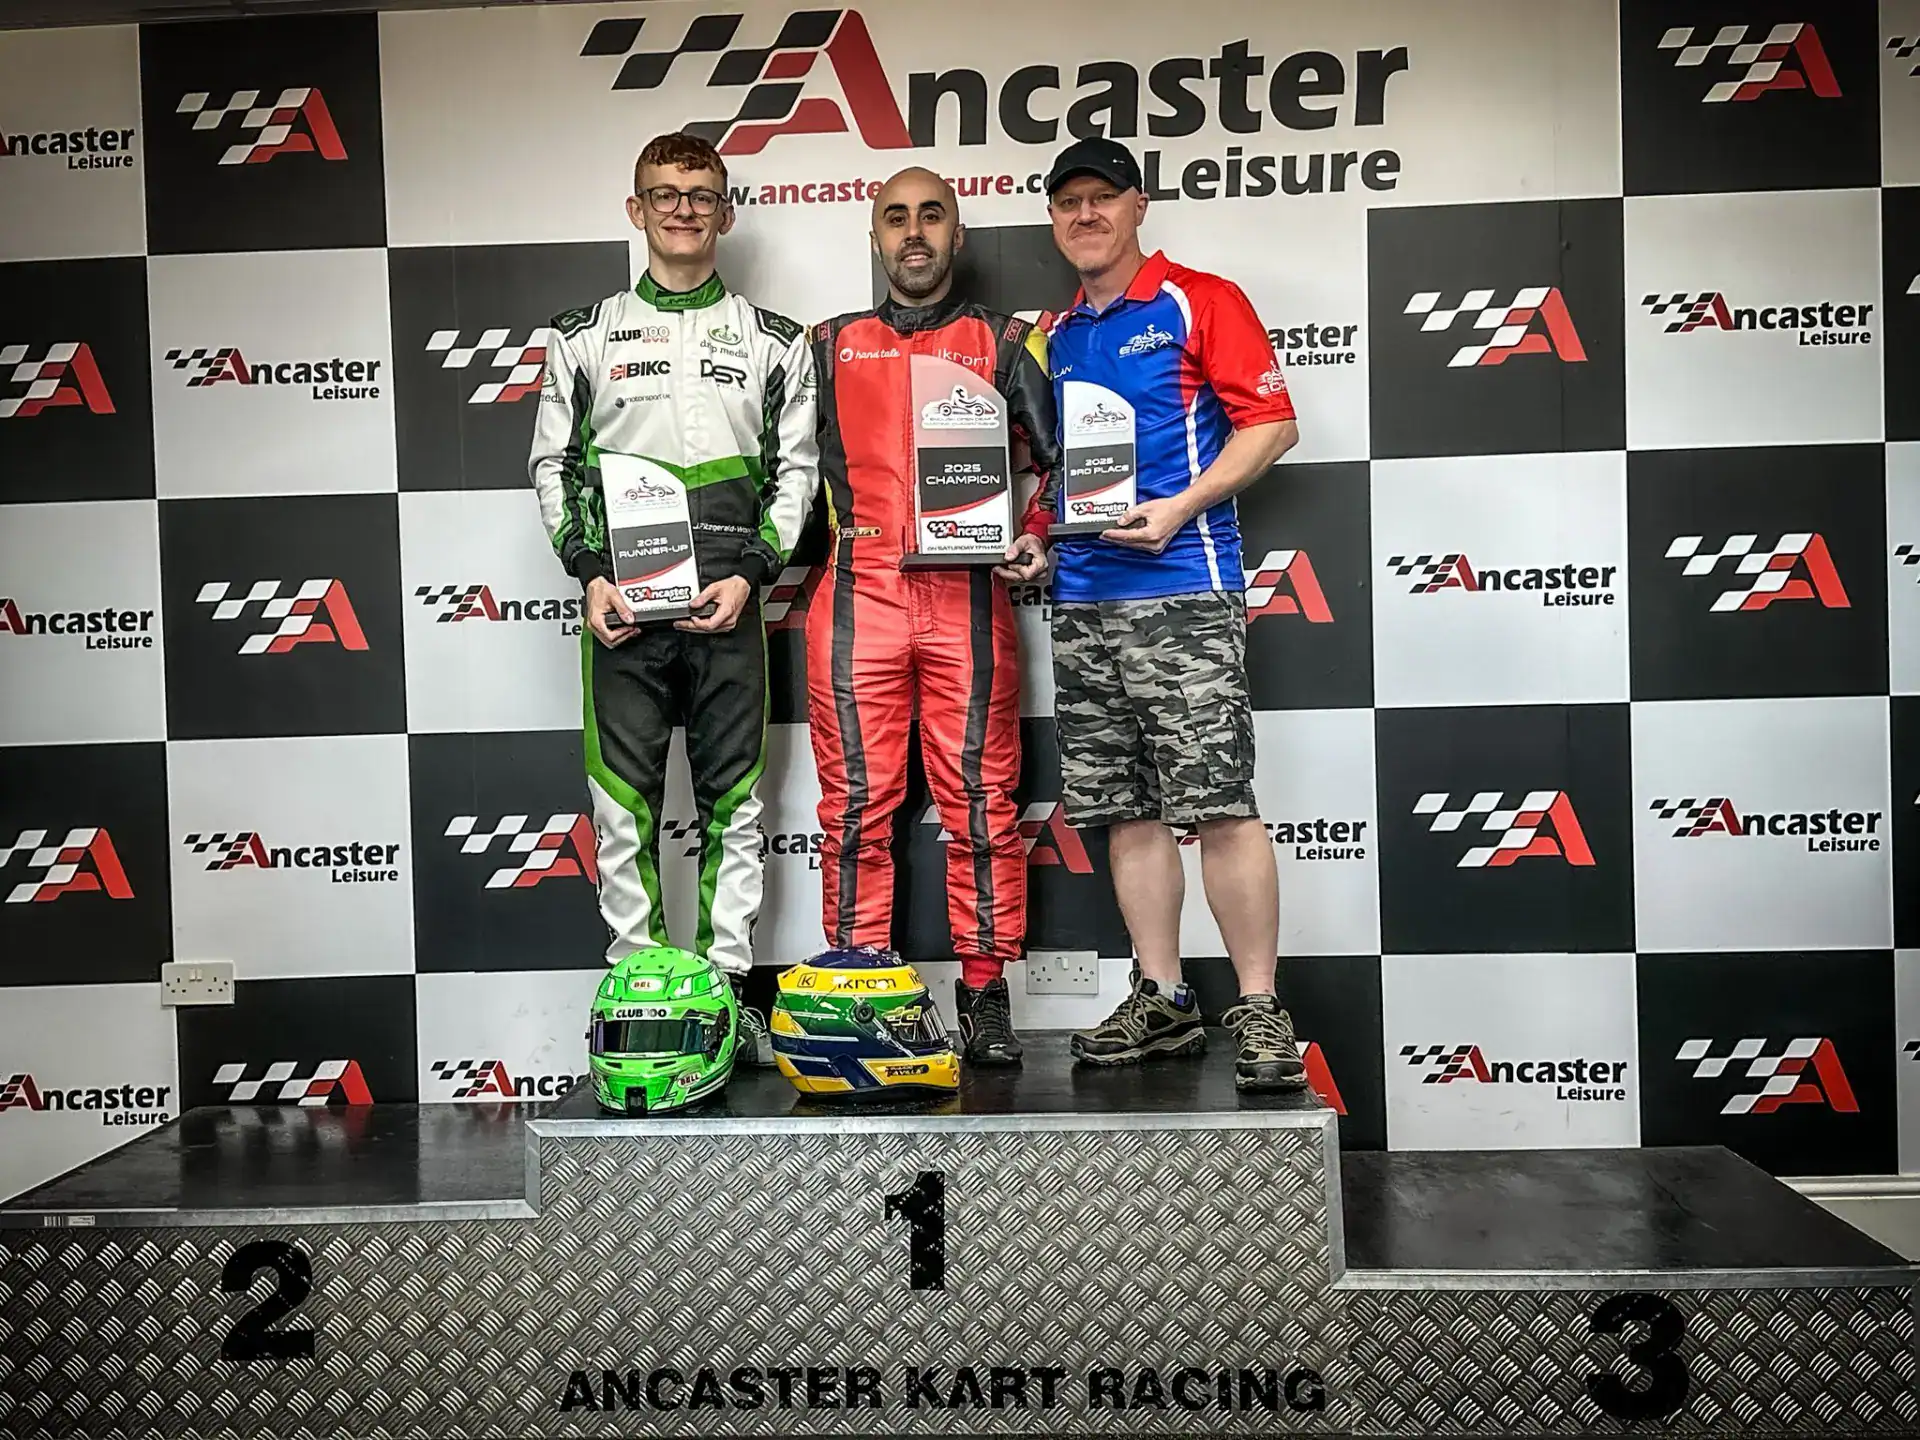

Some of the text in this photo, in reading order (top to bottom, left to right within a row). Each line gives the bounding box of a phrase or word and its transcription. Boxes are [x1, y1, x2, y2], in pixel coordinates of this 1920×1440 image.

[718, 8, 1408, 154] Ancaster
[67, 154, 134, 170] Leisure
[1144, 144, 1401, 202] Leisure
[1678, 292, 1873, 332] Ancaster
[1268, 322, 1358, 349] aster
[1799, 330, 1872, 346] Leisure
[720, 346, 749, 359] media
[1285, 350, 1356, 367] Leisure
[200, 348, 381, 387] Ancaster
[627, 360, 671, 378] BIKC
[312, 385, 380, 400] Leisure
[541, 393, 566, 404] edia
[944, 463, 982, 474] 2025
[1085, 457, 1114, 466] 2025
[1094, 464, 1129, 474] PLACE
[925, 475, 1000, 486] CHAMPION
[638, 537, 669, 546] 2025
[618, 544, 689, 559] RUNNER-UP
[1428, 553, 1616, 593] Ancaster
[451, 585, 588, 622] Ancast
[1543, 591, 1615, 606] Leisure
[86, 633, 152, 650] Leisure
[1690, 797, 1881, 838] Ancaster
[219, 832, 399, 870] Ancaster
[1295, 845, 1366, 861] Leisure
[1807, 836, 1880, 853] Leisure
[331, 867, 399, 883] Leisure
[1441, 1044, 1627, 1084] Ancaster
[466, 1060, 574, 1097] Anca
[680, 1073, 699, 1086] BELL
[6, 1074, 170, 1111] Ancaster
[1556, 1085, 1626, 1101] Leisure
[102, 1109, 169, 1126] Leisure
[884, 1171, 947, 1291] 1
[220, 1239, 316, 1361] 2
[1588, 1294, 1689, 1423] 3
[559, 1366, 1328, 1413] ANCASTER KART RACING
